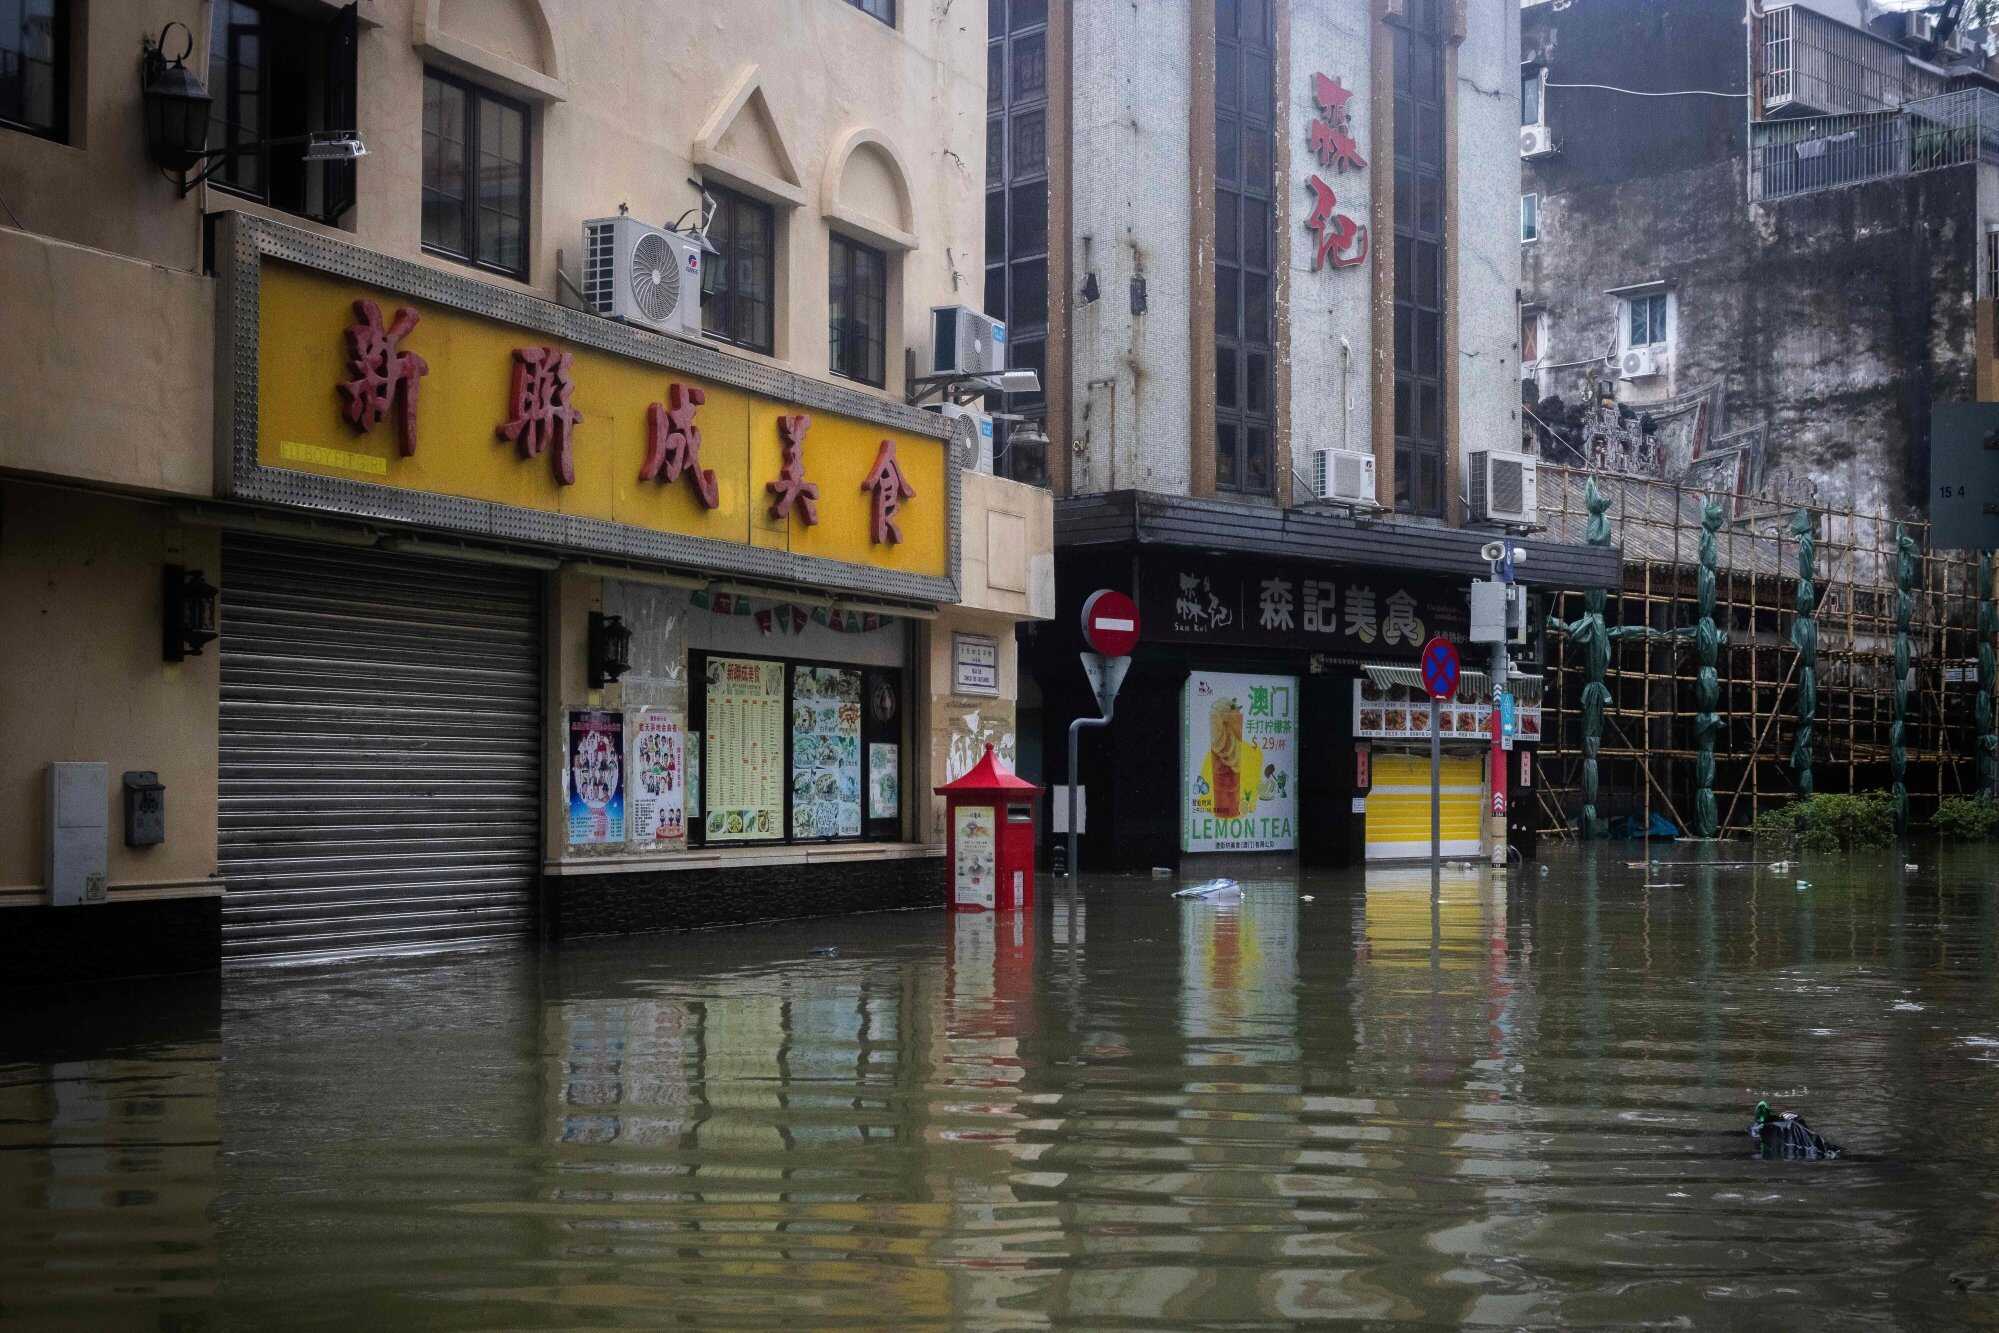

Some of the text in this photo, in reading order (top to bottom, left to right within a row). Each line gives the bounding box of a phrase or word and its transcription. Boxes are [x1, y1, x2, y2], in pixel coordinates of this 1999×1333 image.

[336, 298, 917, 545] 新聯成美食
[1939, 486, 1965, 498] 15 4
[1259, 577, 1418, 639] 森記美食
[1248, 685, 1290, 717] 澳门
[1192, 817, 1292, 839] LEMON TEA
